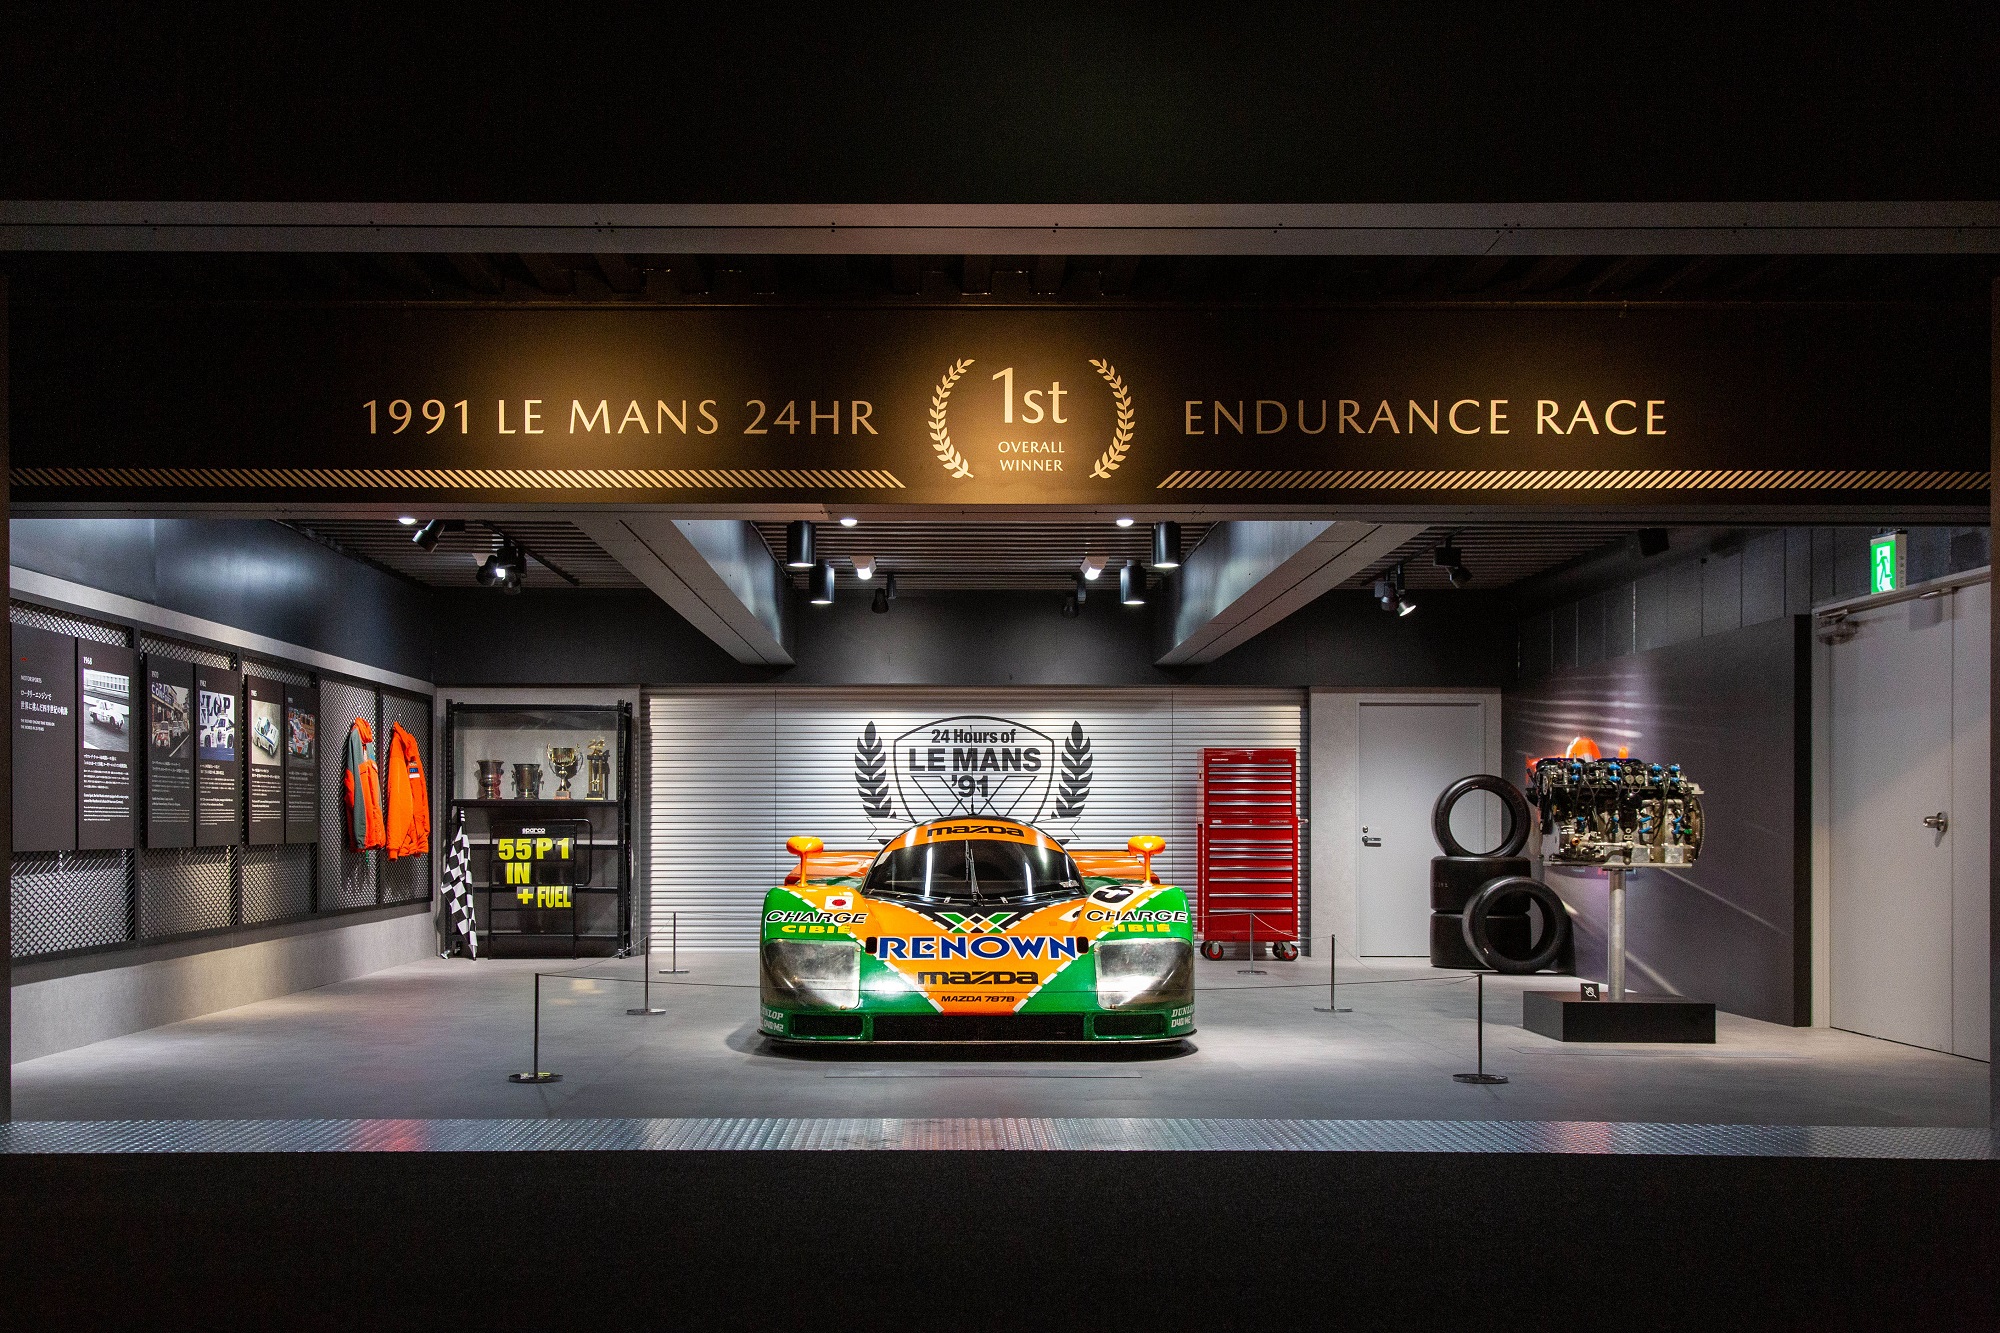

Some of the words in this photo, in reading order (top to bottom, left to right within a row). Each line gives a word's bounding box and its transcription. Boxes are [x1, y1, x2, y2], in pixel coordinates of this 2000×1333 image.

[992, 367, 1068, 424] 1st
[363, 399, 468, 435] 1991
[498, 399, 545, 434] LE
[569, 399, 719, 435] MANS
[743, 399, 879, 435] 24HR
[1185, 399, 1510, 435] ENDURANCE
[1536, 399, 1667, 436] RACE
[997, 441, 1065, 453] OVERALL
[999, 459, 1064, 472] WINNER
[931, 728, 951, 744] 24
[953, 728, 999, 744] Hours
[1000, 728, 1017, 744] of
[908, 748, 946, 772] LE
[952, 747, 1042, 772] MANS
[506, 862, 531, 885] IN
[537, 886, 572, 909] FUEL
[765, 909, 868, 925] CHARGE
[1085, 910, 1189, 923] CHARGE
[877, 936, 1078, 960] RENOWN
[941, 995, 982, 1003] MAZDA
